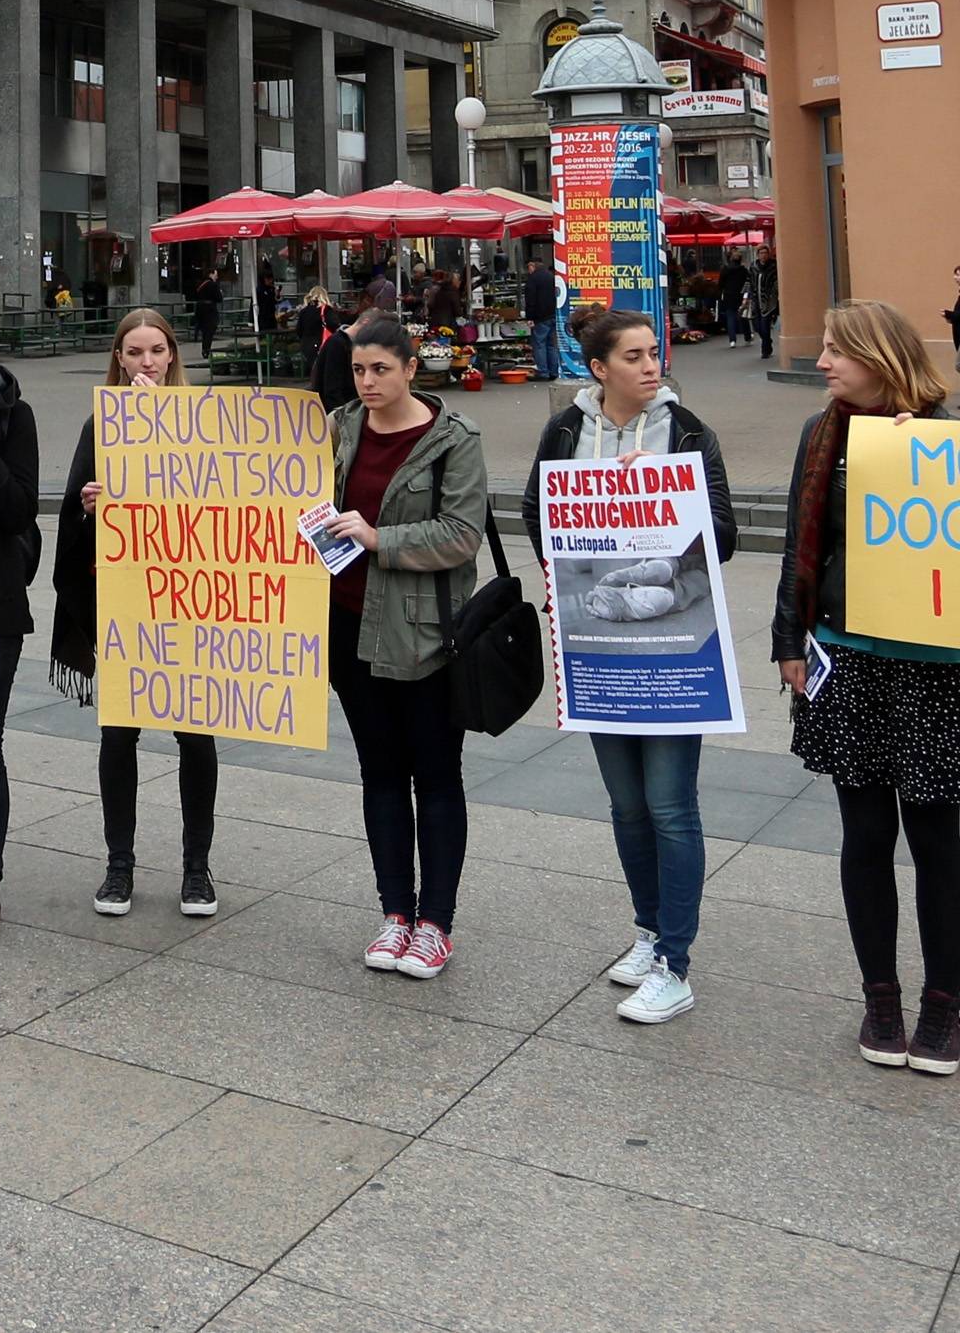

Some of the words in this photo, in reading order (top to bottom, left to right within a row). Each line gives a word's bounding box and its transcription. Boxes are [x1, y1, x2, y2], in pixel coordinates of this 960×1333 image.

[890, 23, 931, 37] JELAČIĆA
[664, 95, 695, 111] Čevapi
[706, 95, 742, 107] somunu
[619, 143, 644, 153] 2016.
[566, 198, 594, 209] JUSTIN
[597, 198, 638, 209] KAUFLIN
[567, 221, 595, 232] VESNA
[599, 219, 648, 232] PISAROVIĆ
[568, 254, 601, 264] PAWEL
[568, 266, 643, 277] KACZMARCZYK
[569, 278, 634, 289] AUDIOFEELING
[637, 278, 653, 289] TRIO
[101, 386, 327, 448] BESKUĆNIŠTVO
[910, 436, 960, 486] M
[105, 455, 127, 499] U
[145, 451, 323, 499] HRVATSKOJ
[547, 469, 640, 497] SVJETSKI
[643, 464, 696, 494] DAN
[548, 498, 679, 529] BESKUĆNIKA
[102, 503, 318, 565] STRUKTURALA
[551, 536, 567, 552] 10.
[568, 535, 617, 555] Listopada
[145, 566, 286, 624] PROBLEM
[105, 619, 126, 661] A
[138, 622, 181, 667] NE
[194, 625, 321, 678] PROBLEM
[129, 667, 295, 736] POJEDINCA
